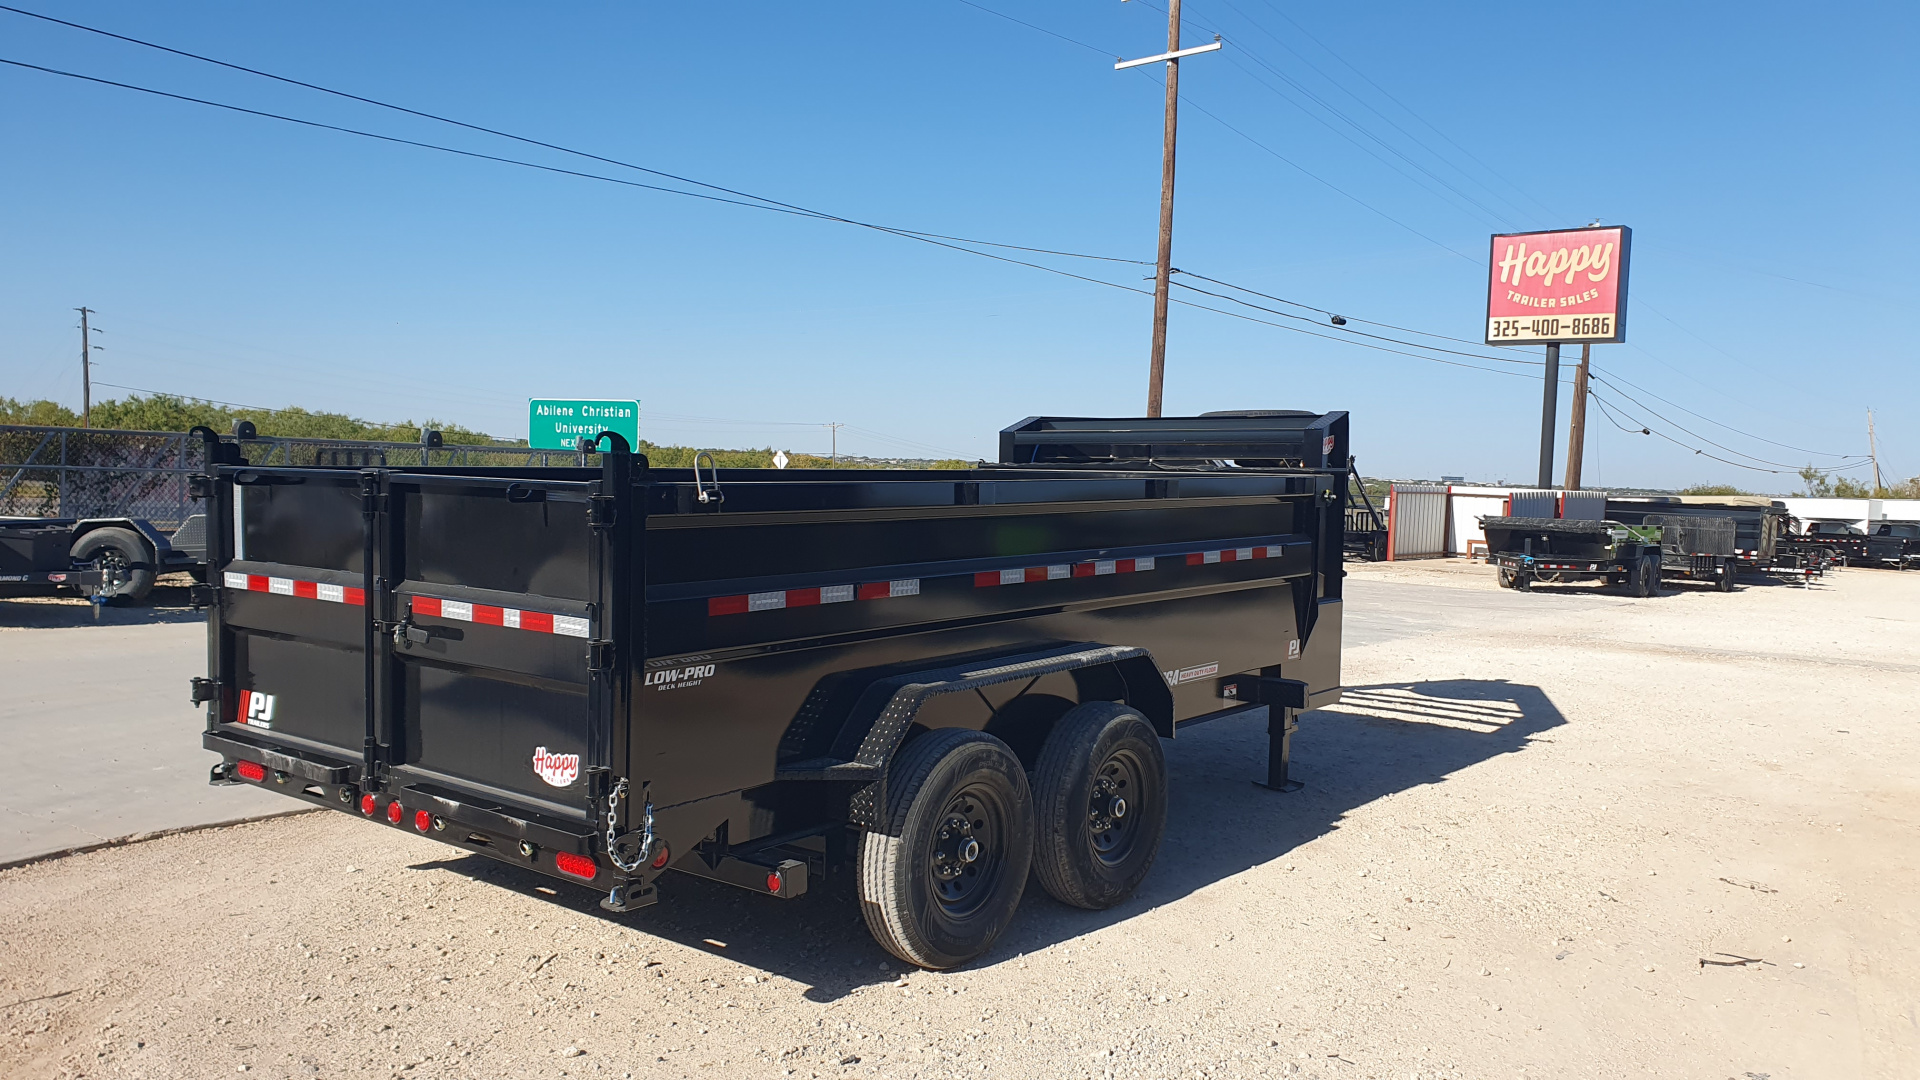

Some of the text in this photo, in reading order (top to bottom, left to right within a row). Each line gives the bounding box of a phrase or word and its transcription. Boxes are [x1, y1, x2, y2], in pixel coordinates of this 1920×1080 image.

[1498, 243, 1613, 287] Happy
[1506, 288, 1599, 308] TRAILER SALES
[1493, 317, 1610, 337] 325-400-8686
[536, 404, 631, 418] Abilene Christian
[555, 422, 608, 435] University
[644, 664, 715, 686] LOW-PRO
[1194, 669, 1205, 677] DUTY
[1204, 666, 1217, 675] FLOOR
[658, 680, 702, 691] DECK HEIGHT
[248, 691, 273, 721] PJ
[535, 748, 578, 778] Happy
